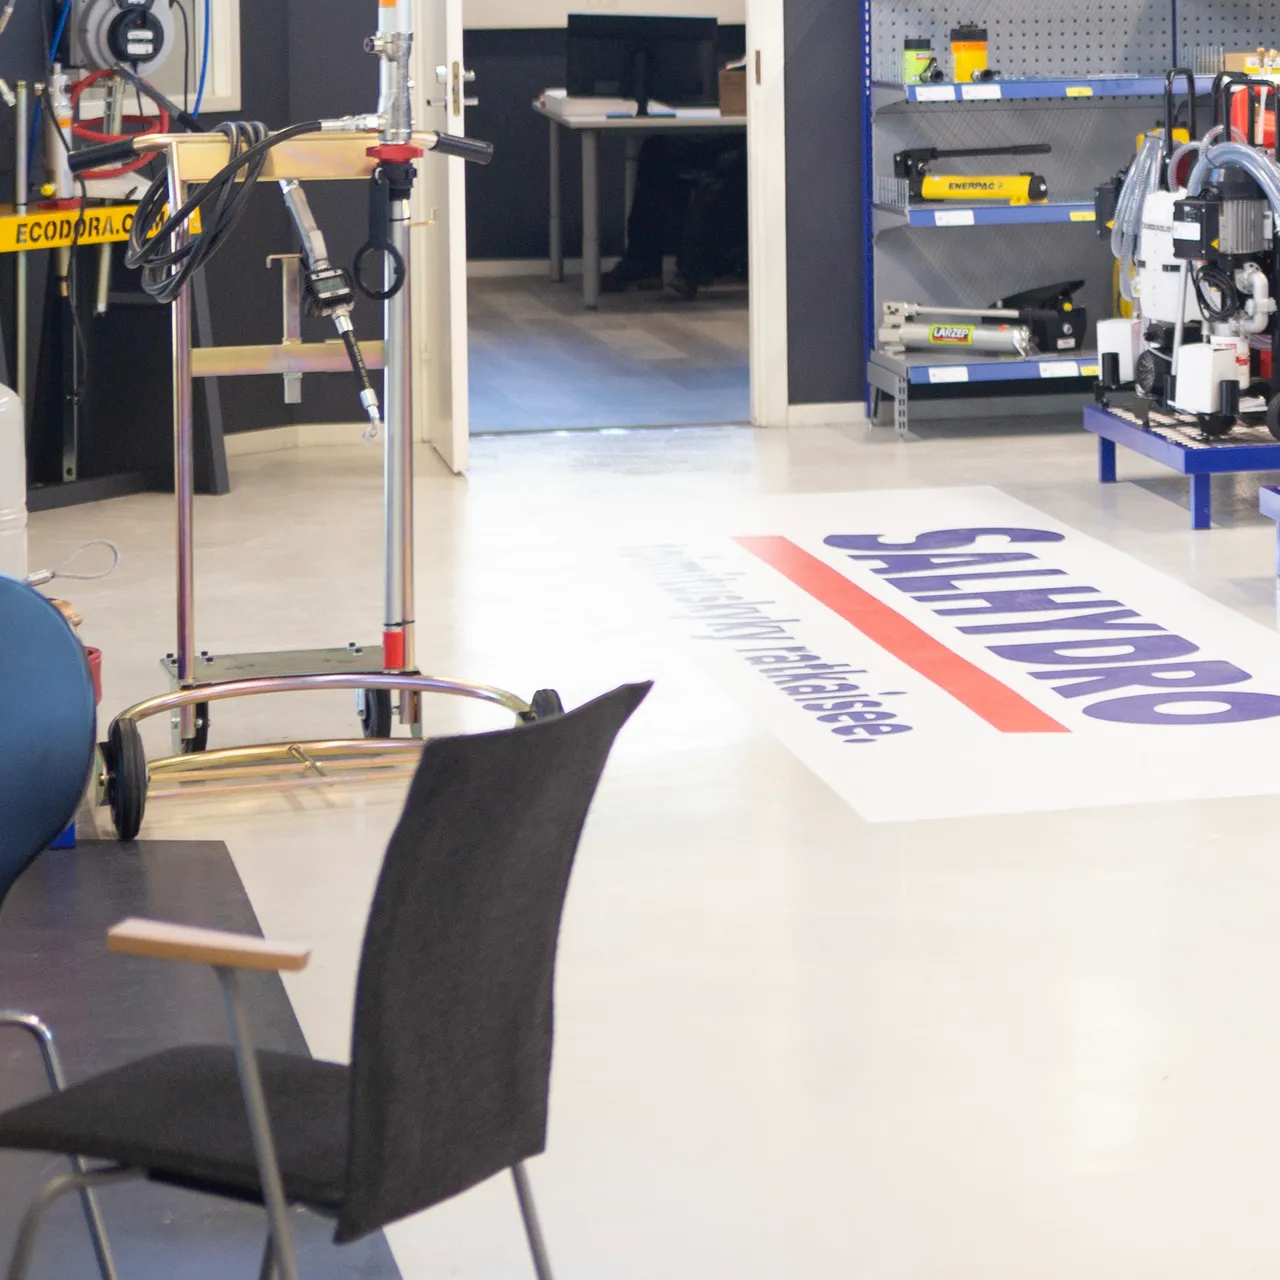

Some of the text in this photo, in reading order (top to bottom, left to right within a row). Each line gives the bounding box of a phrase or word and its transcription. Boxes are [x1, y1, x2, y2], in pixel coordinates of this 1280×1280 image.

[948, 181, 996, 191] ENERPAC
[933, 327, 969, 338] LARZEP
[734, 646, 913, 744] ratkaisee.
